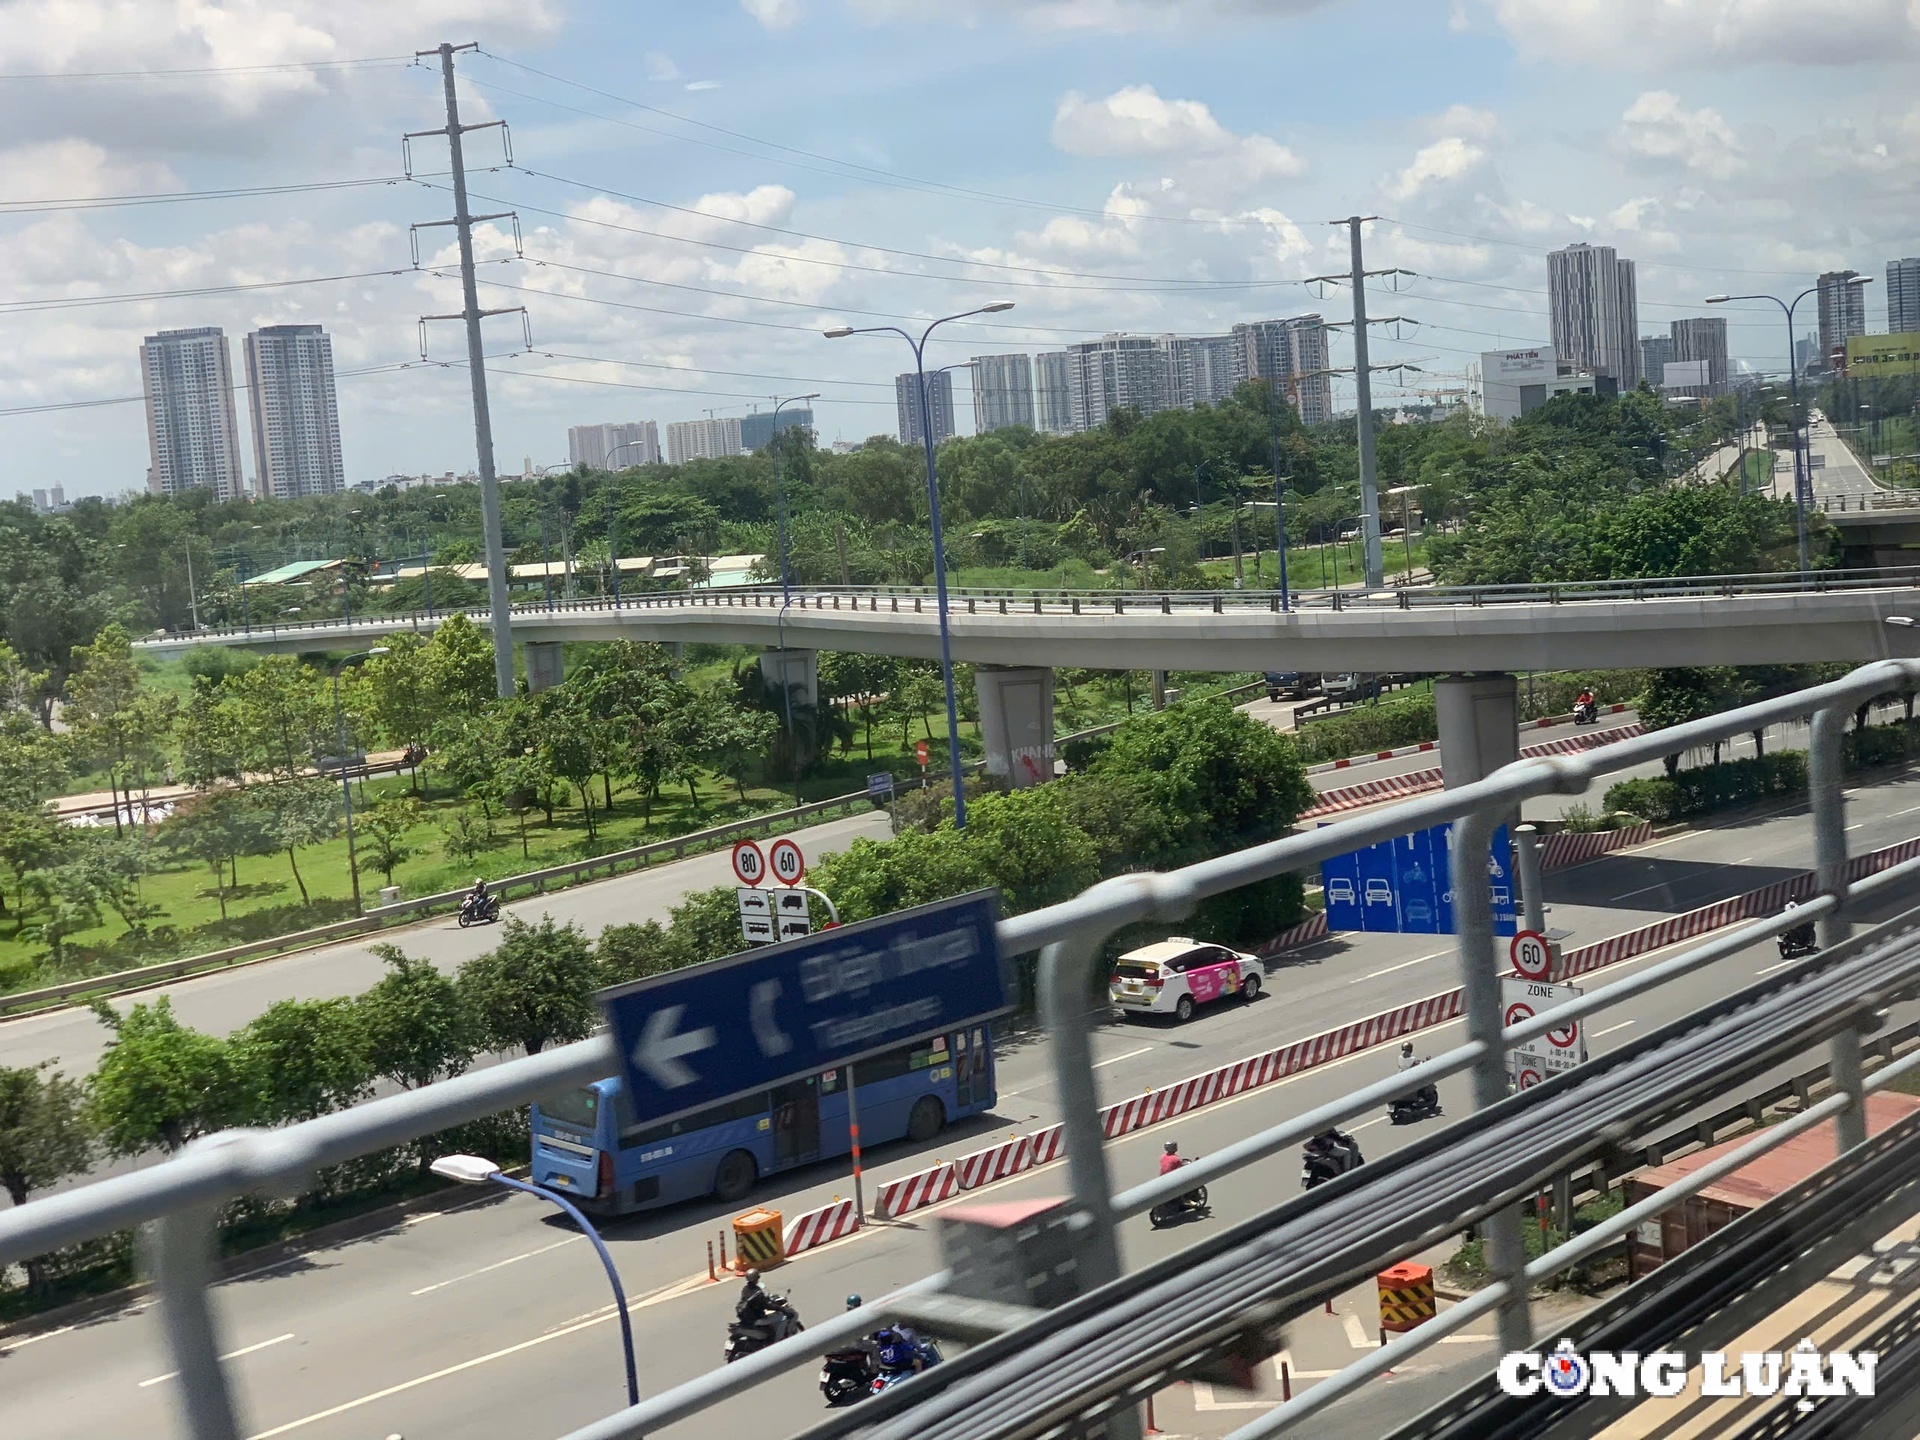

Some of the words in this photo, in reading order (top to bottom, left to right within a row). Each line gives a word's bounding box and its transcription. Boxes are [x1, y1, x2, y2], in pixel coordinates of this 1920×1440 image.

[741, 853, 756, 873] 80
[780, 852, 795, 872] 60
[1522, 943, 1540, 966] 60
[1527, 984, 1554, 998] ZONE
[1521, 1055, 1537, 1068] ZONE
